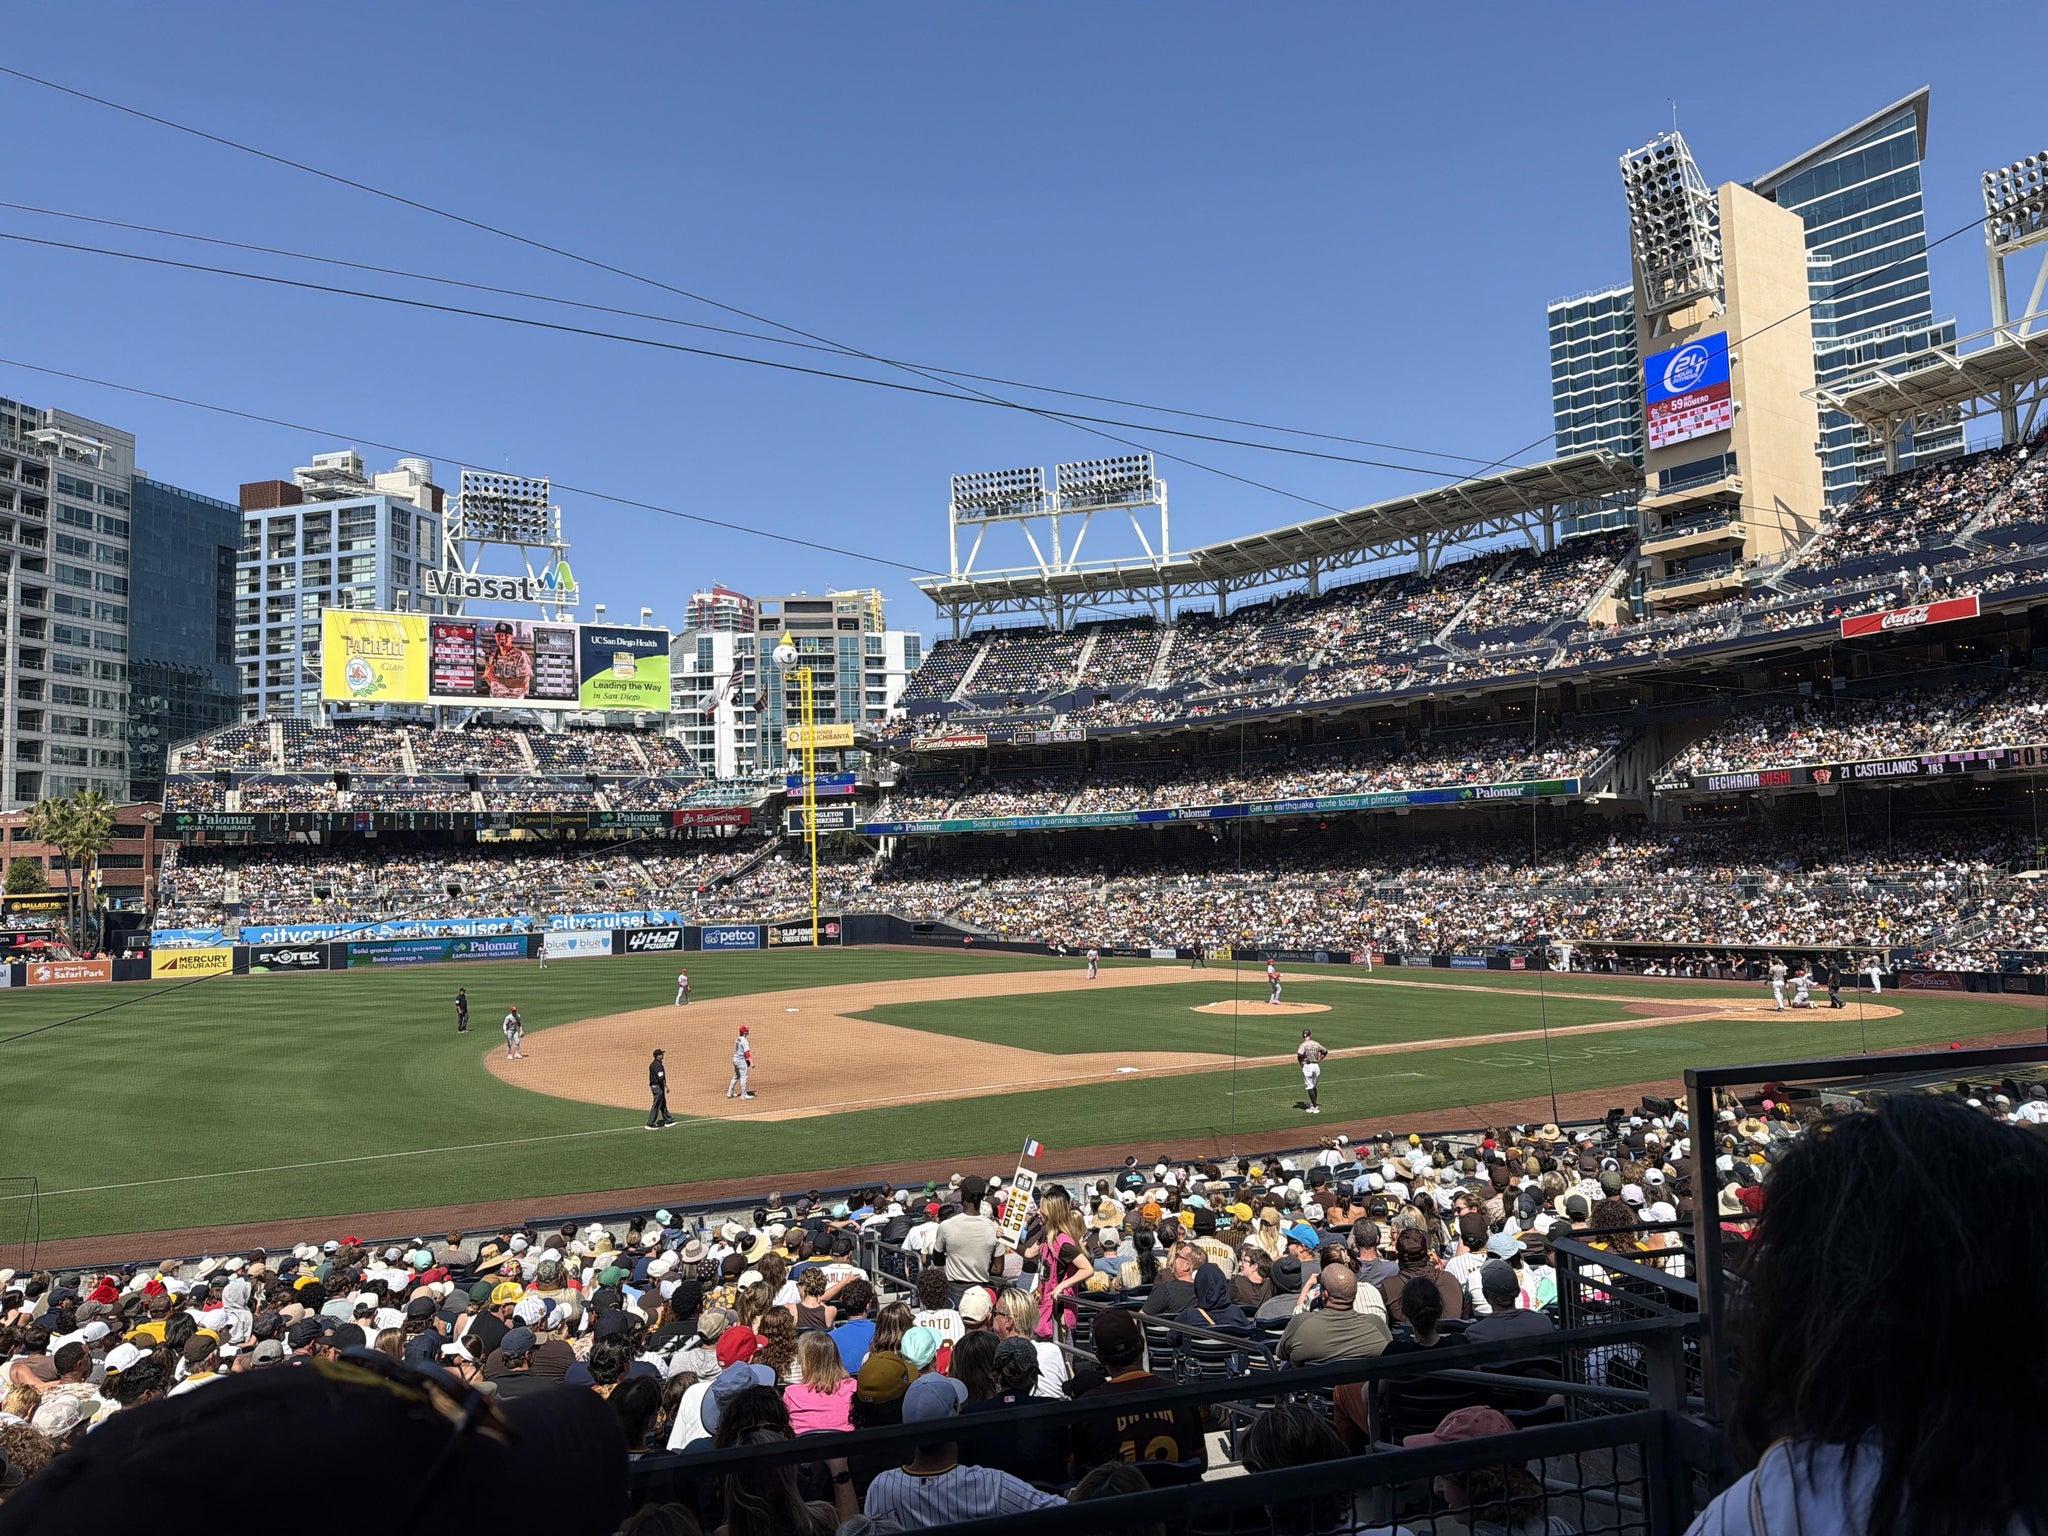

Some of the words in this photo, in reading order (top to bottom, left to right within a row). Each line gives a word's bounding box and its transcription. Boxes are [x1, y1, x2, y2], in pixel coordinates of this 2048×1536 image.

[1671, 398, 1683, 412] 59
[1684, 395, 1709, 408] ROMERO
[432, 571, 533, 601] Viasat
[591, 636, 603, 645] UC
[603, 637, 616, 645] San
[617, 638, 635, 647] Diego
[636, 639, 657, 647] Health
[593, 681, 627, 690] Leading
[629, 682, 642, 690] the
[644, 683, 662, 692] Way
[620, 693, 641, 701] Diego
[817, 733, 850, 741] ICHIBANYA
[954, 739, 985, 747] SAUSAGES
[2013, 753, 2019, 762] B
[2042, 751, 2048, 760] S
[1841, 767, 1850, 779] 21
[1854, 760, 1918, 777] CASTELLANOS
[1960, 762, 1965, 772] 1
[1987, 759, 1997, 770] 11
[1760, 771, 1791, 785] SUSHI
[1475, 787, 1523, 799] Palomar
[1250, 804, 1262, 812] Get
[1274, 801, 1314, 811] earthquake
[1316, 799, 1337, 809] quote
[1338, 798, 1359, 808] today
[327, 813, 333, 821] 4
[369, 813, 374, 821] 6
[409, 813, 414, 821] 5
[617, 813, 662, 822] Palomar
[1178, 808, 1211, 819] Palomar
[197, 814, 254, 825] Palomar
[300, 817, 305, 826] F
[342, 817, 347, 826] F
[383, 817, 389, 826] F
[424, 817, 429, 826] F
[464, 817, 468, 825] F
[697, 814, 742, 823] Budweiser
[972, 820, 990, 828] Solid
[992, 820, 1017, 829] ground
[1018, 818, 1034, 826] isn't
[1041, 817, 1079, 827] guarantee.
[1101, 814, 1132, 822] coverage
[284, 822, 290, 831] 2
[409, 822, 415, 830] 4
[449, 822, 454, 830] 2
[905, 823, 941, 832] Palomar
[721, 930, 755, 943] petco
[782, 928, 797, 936] SLAP
[646, 931, 679, 943] H2O
[470, 941, 519, 952] Palomar
[546, 941, 567, 949] blue
[580, 939, 601, 947] blue
[179, 955, 228, 963] MERCURY
[260, 950, 320, 964] EVOTEK
[54, 970, 82, 979] Safari
[83, 969, 105, 978] Park
[1910, 973, 1949, 988] Sycuan
[921, 1318, 950, 1330] SOTO
